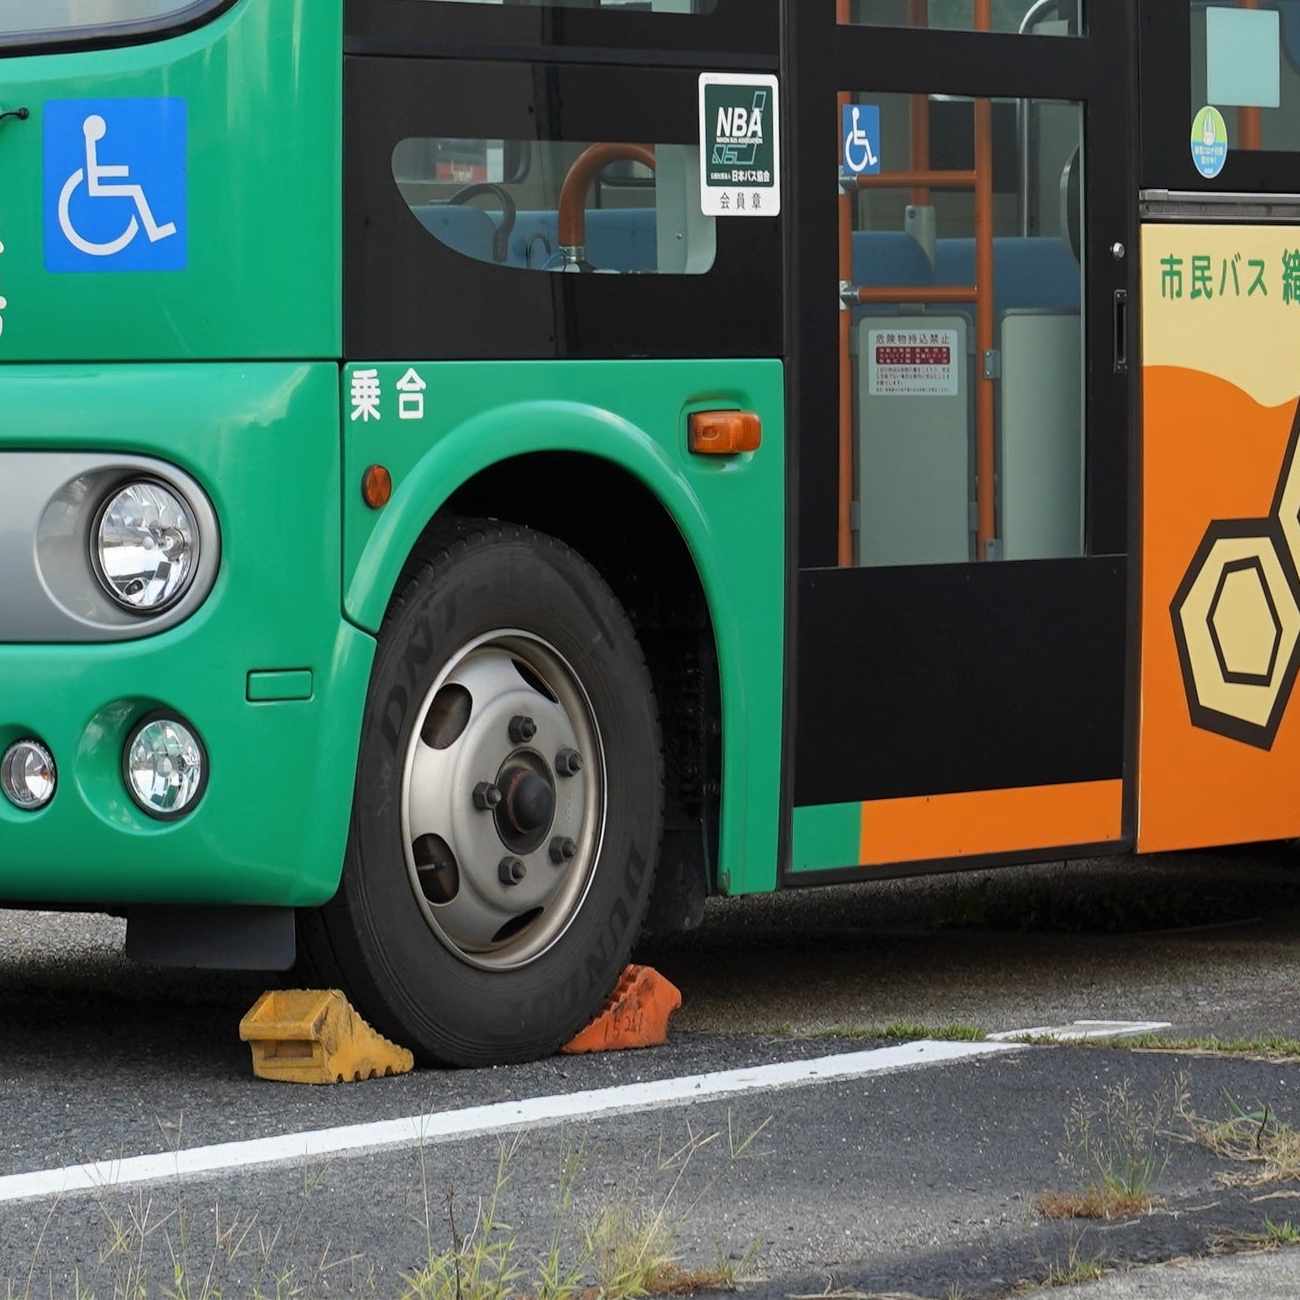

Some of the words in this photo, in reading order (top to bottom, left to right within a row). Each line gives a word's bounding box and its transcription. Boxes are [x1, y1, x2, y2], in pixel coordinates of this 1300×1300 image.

[716, 106, 763, 137] NBA
[731, 170, 771, 183] 日本バス協会
[720, 191, 762, 210] 会員章
[1160, 252, 1268, 300] 市民バス
[876, 333, 950, 344] 危険物持込禁止
[350, 367, 427, 422] 乗合
